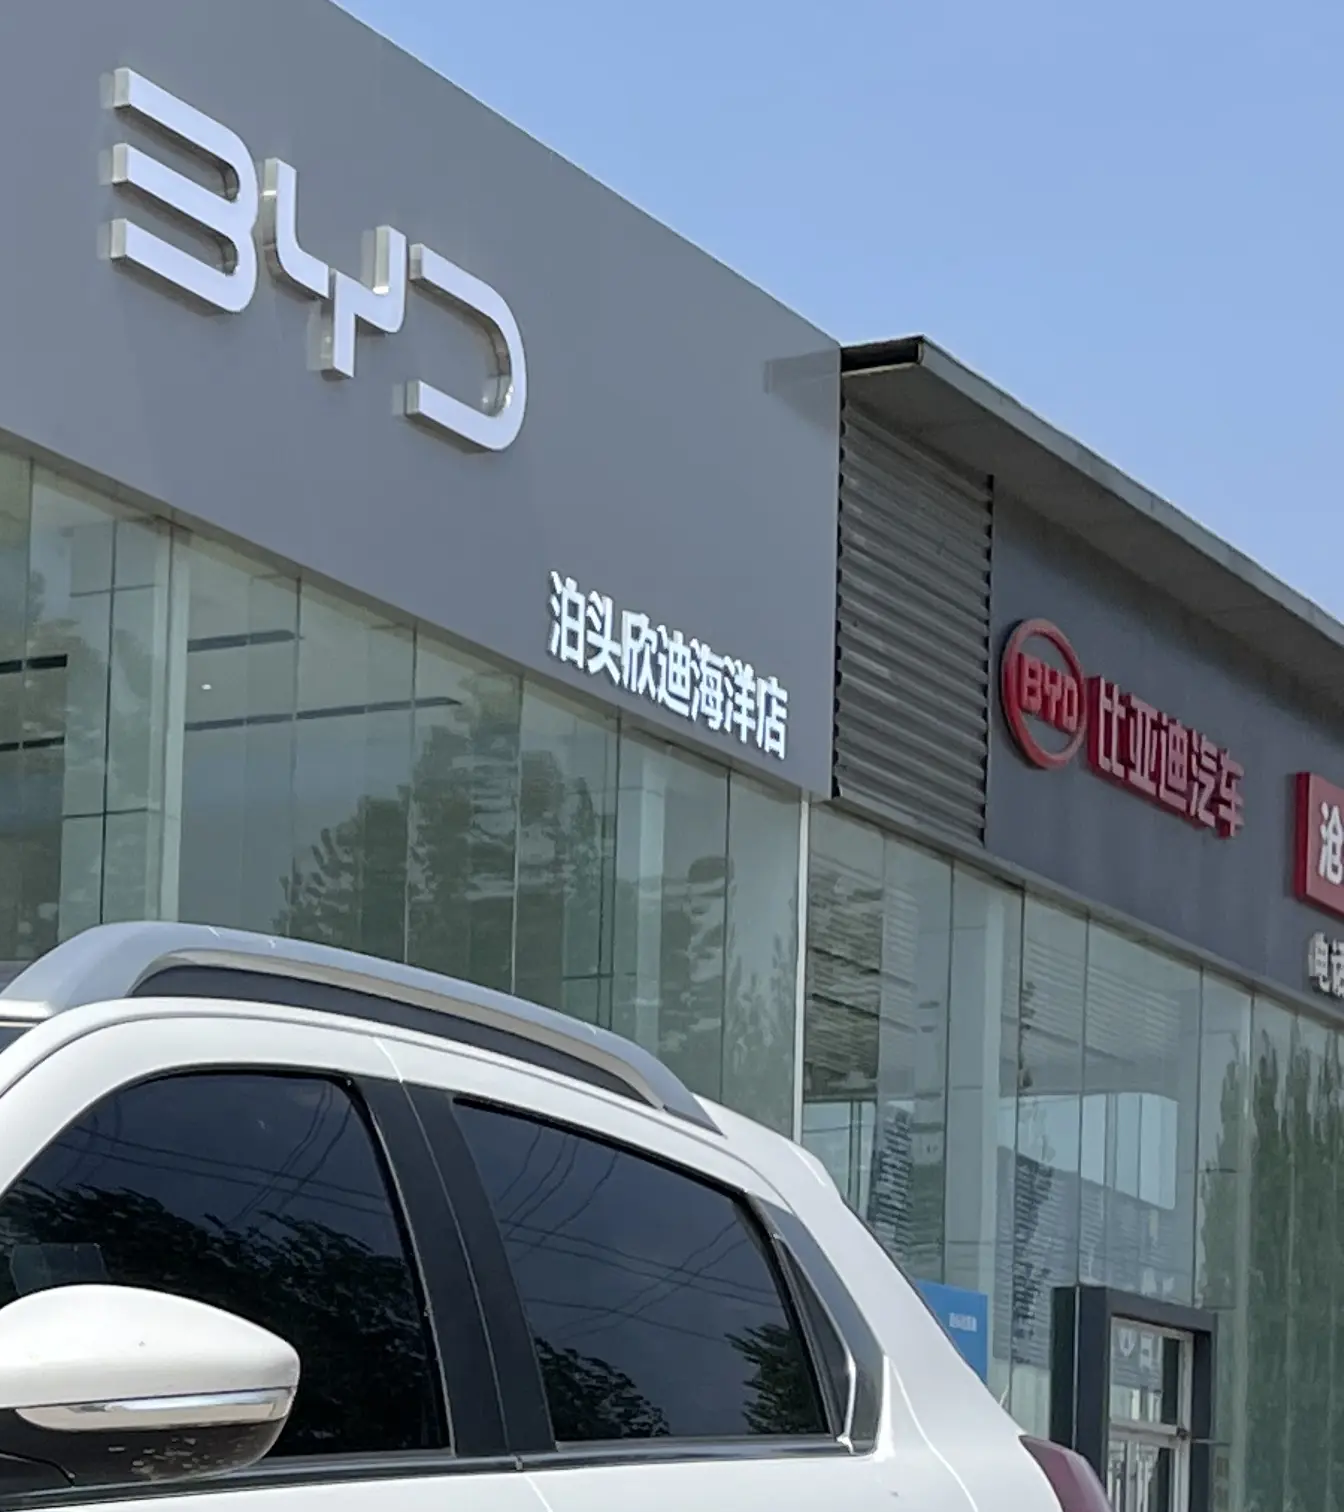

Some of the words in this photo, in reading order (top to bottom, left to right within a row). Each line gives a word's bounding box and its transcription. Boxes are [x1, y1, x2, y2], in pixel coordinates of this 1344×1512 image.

[111, 67, 528, 452] BYD
[549, 571, 788, 760] 泊头欣迪海洋店
[1017, 652, 1079, 733] BYD
[1088, 675, 1245, 838] 比亚迪汽车
